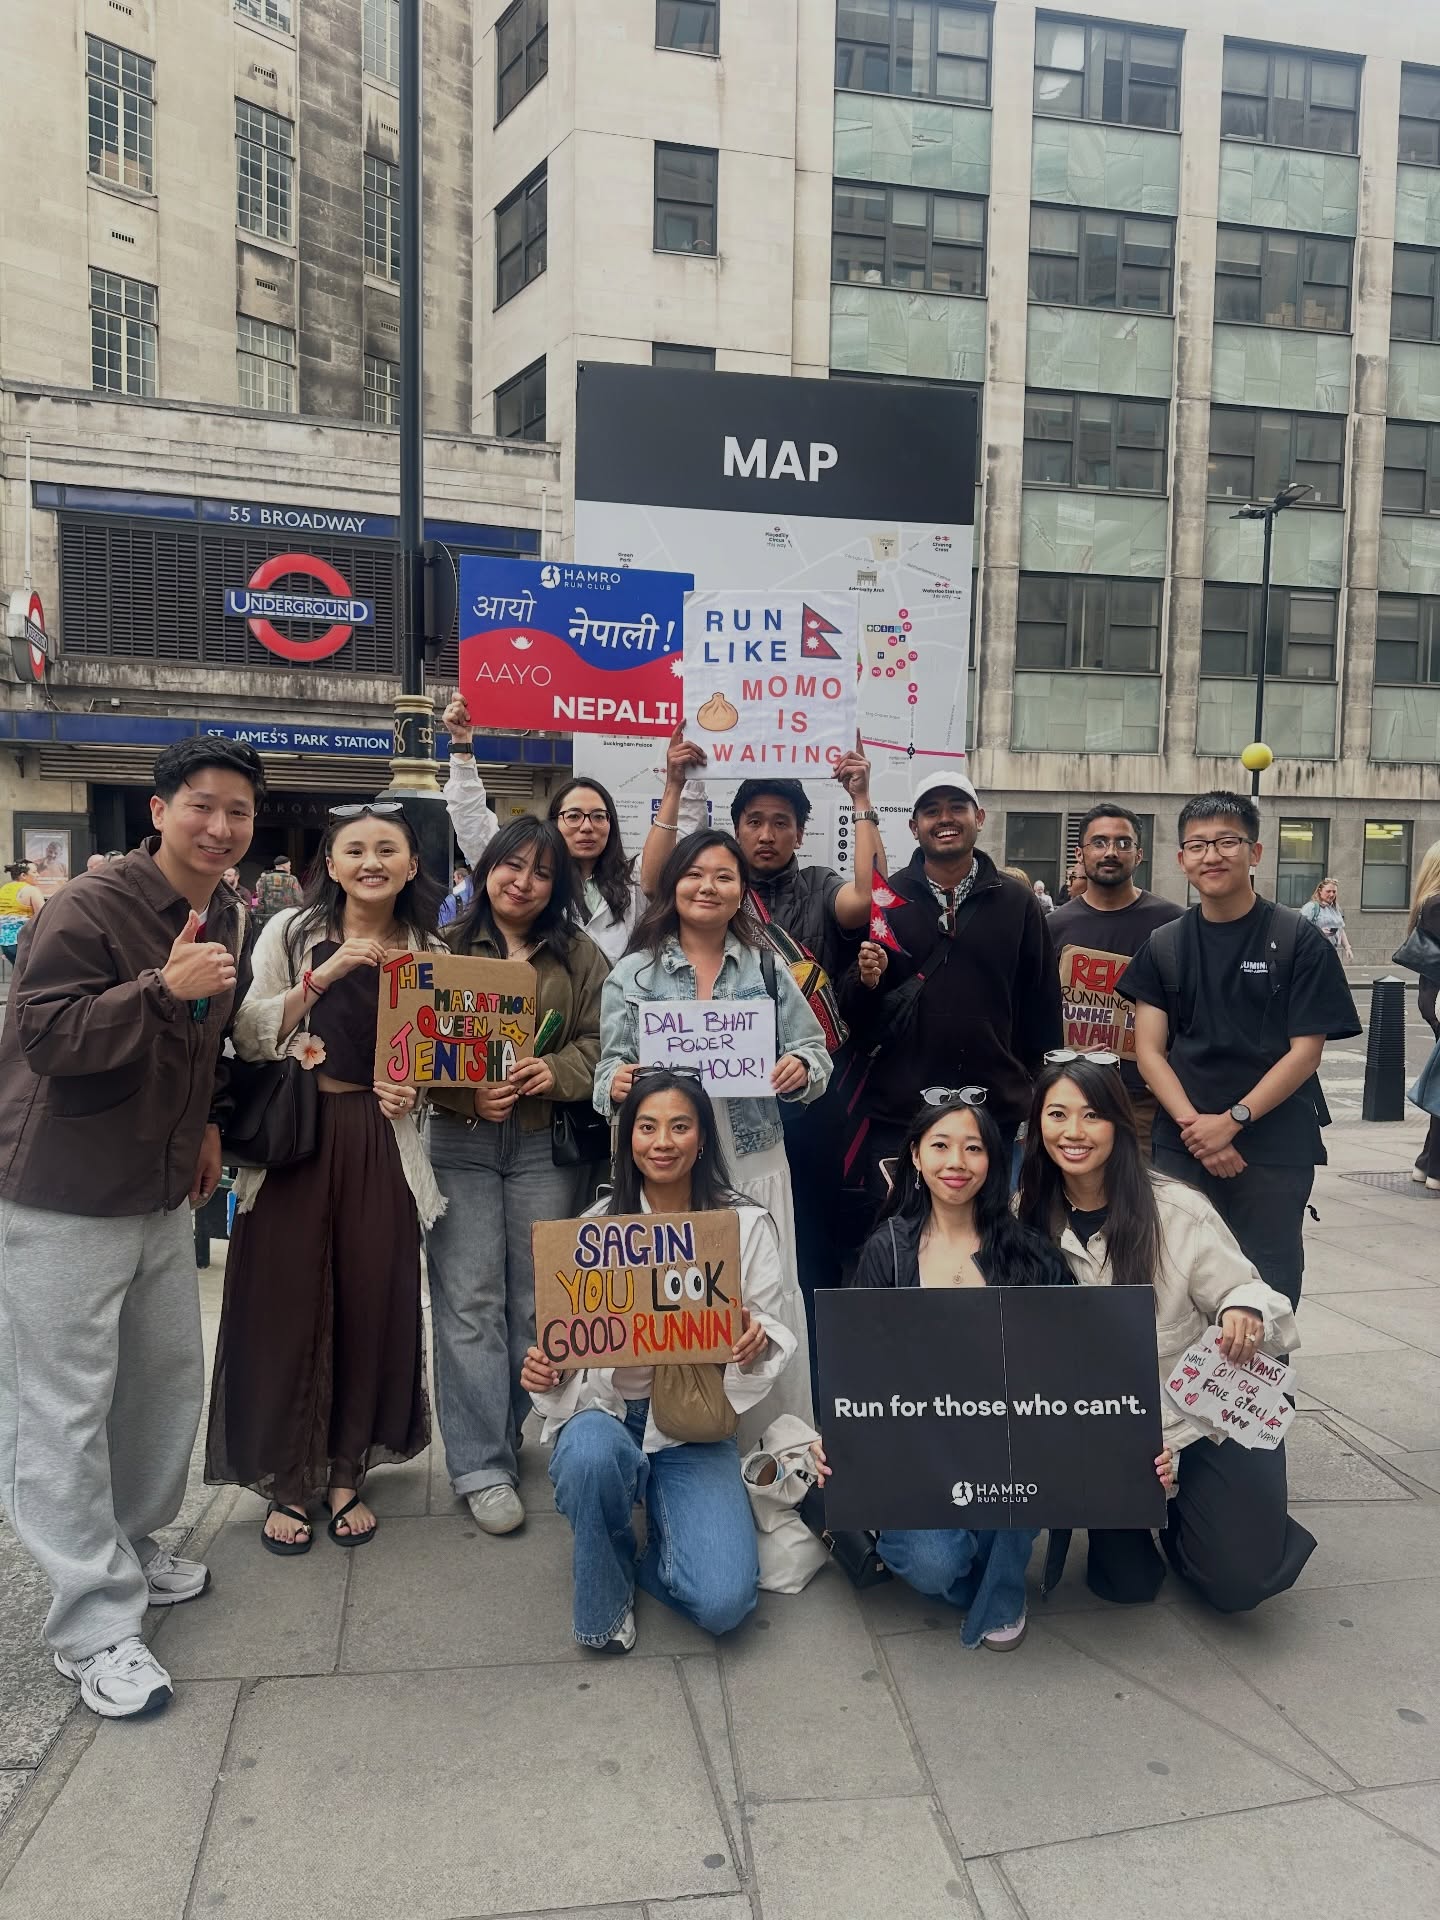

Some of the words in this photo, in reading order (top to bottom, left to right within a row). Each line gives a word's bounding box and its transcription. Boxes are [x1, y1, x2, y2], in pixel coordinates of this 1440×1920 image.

[723, 435, 838, 482] MAP
[229, 506, 251, 522] 55
[260, 508, 366, 533] BROADWAY
[564, 569, 621, 584] HAMRO
[564, 581, 583, 589] RUN
[587, 583, 612, 591] CLUB
[230, 591, 368, 622] UNDERGROUND
[472, 589, 538, 623] आयो
[706, 609, 782, 632] RUN
[704, 640, 787, 663] LIKE
[475, 661, 552, 687] AAYO
[742, 674, 842, 701] MOMO
[553, 695, 678, 725] NEPALI!
[777, 709, 808, 733] IS
[294, 733, 329, 747] PARK
[334, 736, 390, 750] STATION
[713, 744, 842, 765] WAITING
[383, 953, 434, 1009] THE
[435, 989, 535, 1015] MARATHON
[417, 1005, 493, 1045] QUEEN
[644, 1012, 694, 1035] DAL
[703, 1011, 759, 1032] BHAT
[387, 1021, 517, 1082] JENISHA
[667, 1033, 735, 1053] POWER
[699, 1057, 765, 1080] HOUR!
[574, 1221, 697, 1270] SAGIN
[556, 1269, 635, 1315] YOU
[542, 1316, 628, 1363] GOOD
[834, 1397, 883, 1417] Run
[889, 1394, 928, 1417] for
[933, 1393, 1007, 1417] those
[1012, 1393, 1068, 1416] who
[1073, 1394, 1148, 1416] can't.
[976, 1483, 1038, 1495] HAMRO
